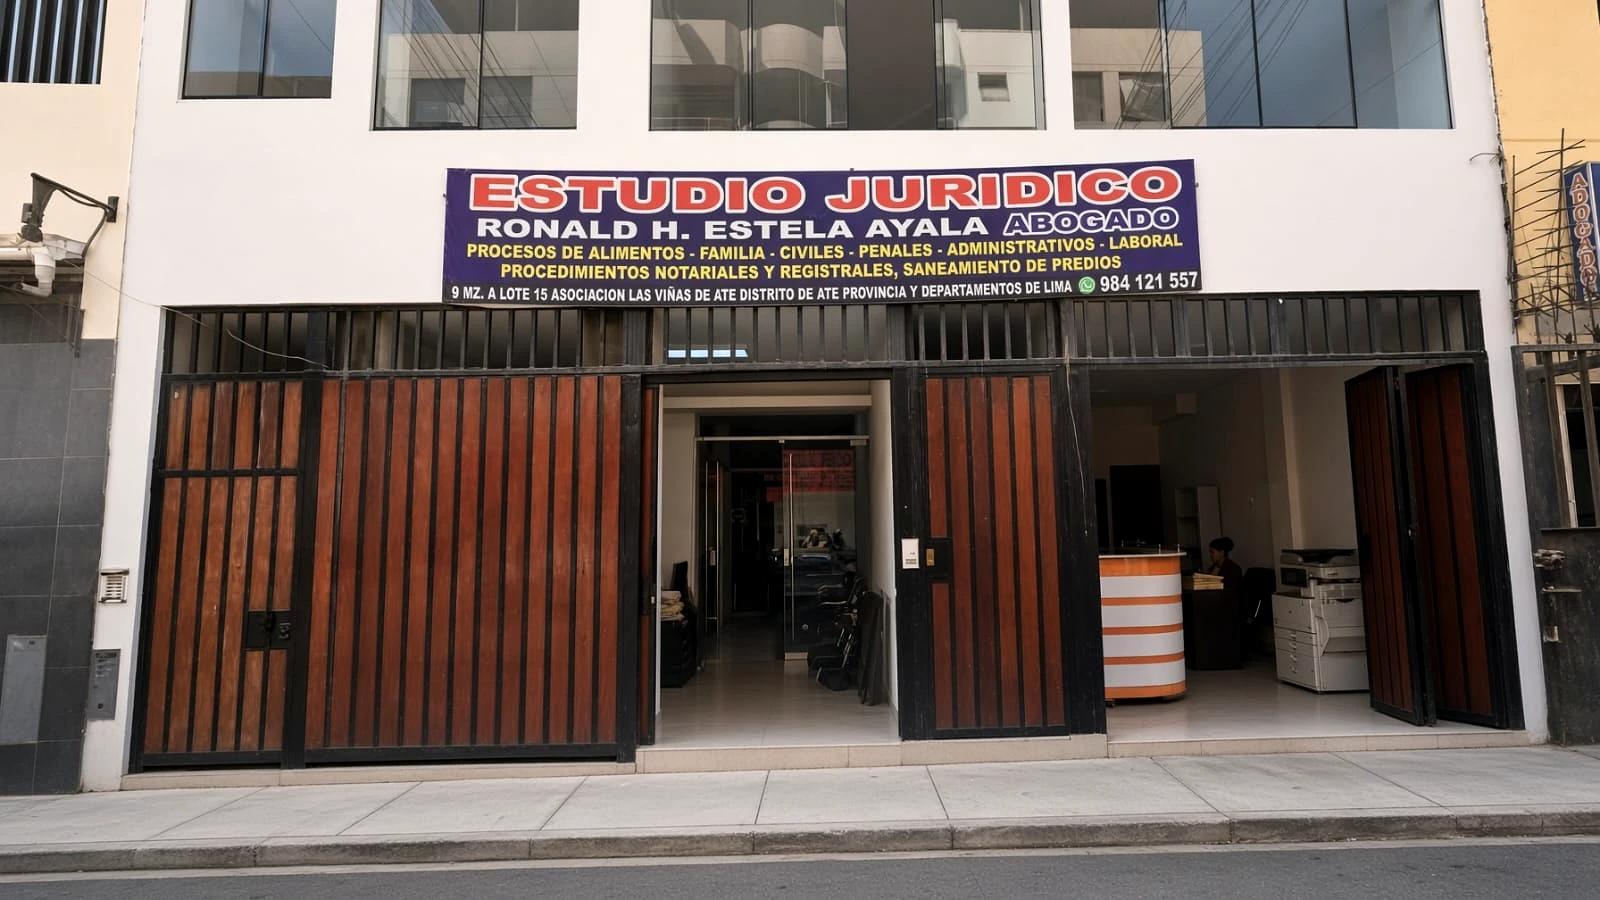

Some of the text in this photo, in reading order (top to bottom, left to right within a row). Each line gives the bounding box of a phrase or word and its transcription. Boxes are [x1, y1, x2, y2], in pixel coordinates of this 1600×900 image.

[469, 166, 1182, 213] ESTUDIO JURIDICO
[478, 206, 1180, 239] RONALD H. ESTELA AYALA ABOGADO
[468, 244, 556, 259] PROCESOS
[562, 246, 583, 259] DE
[589, 246, 684, 260] ALIMENTOS
[700, 247, 765, 259] FAMILIA
[780, 245, 844, 259] CIVILES
[860, 244, 932, 258] PENALES
[947, 238, 1096, 257] ADMINISTRATIVOS
[1110, 234, 1183, 249] LABORAL
[502, 256, 1121, 280] PROCEDIMIENTOS NOTARIALES Y REGISTRALES, SANEAMIENTO DE PREDIOS
[452, 280, 1072, 301] 9 MZ. A LOTE 15 ASOCIACION LAS VIÑAS DE ATE DISTRITO DE ATE PROVINCIA Y DEPARTAMENTOS DE LIMA
[1101, 271, 1198, 292] 984 121 557
